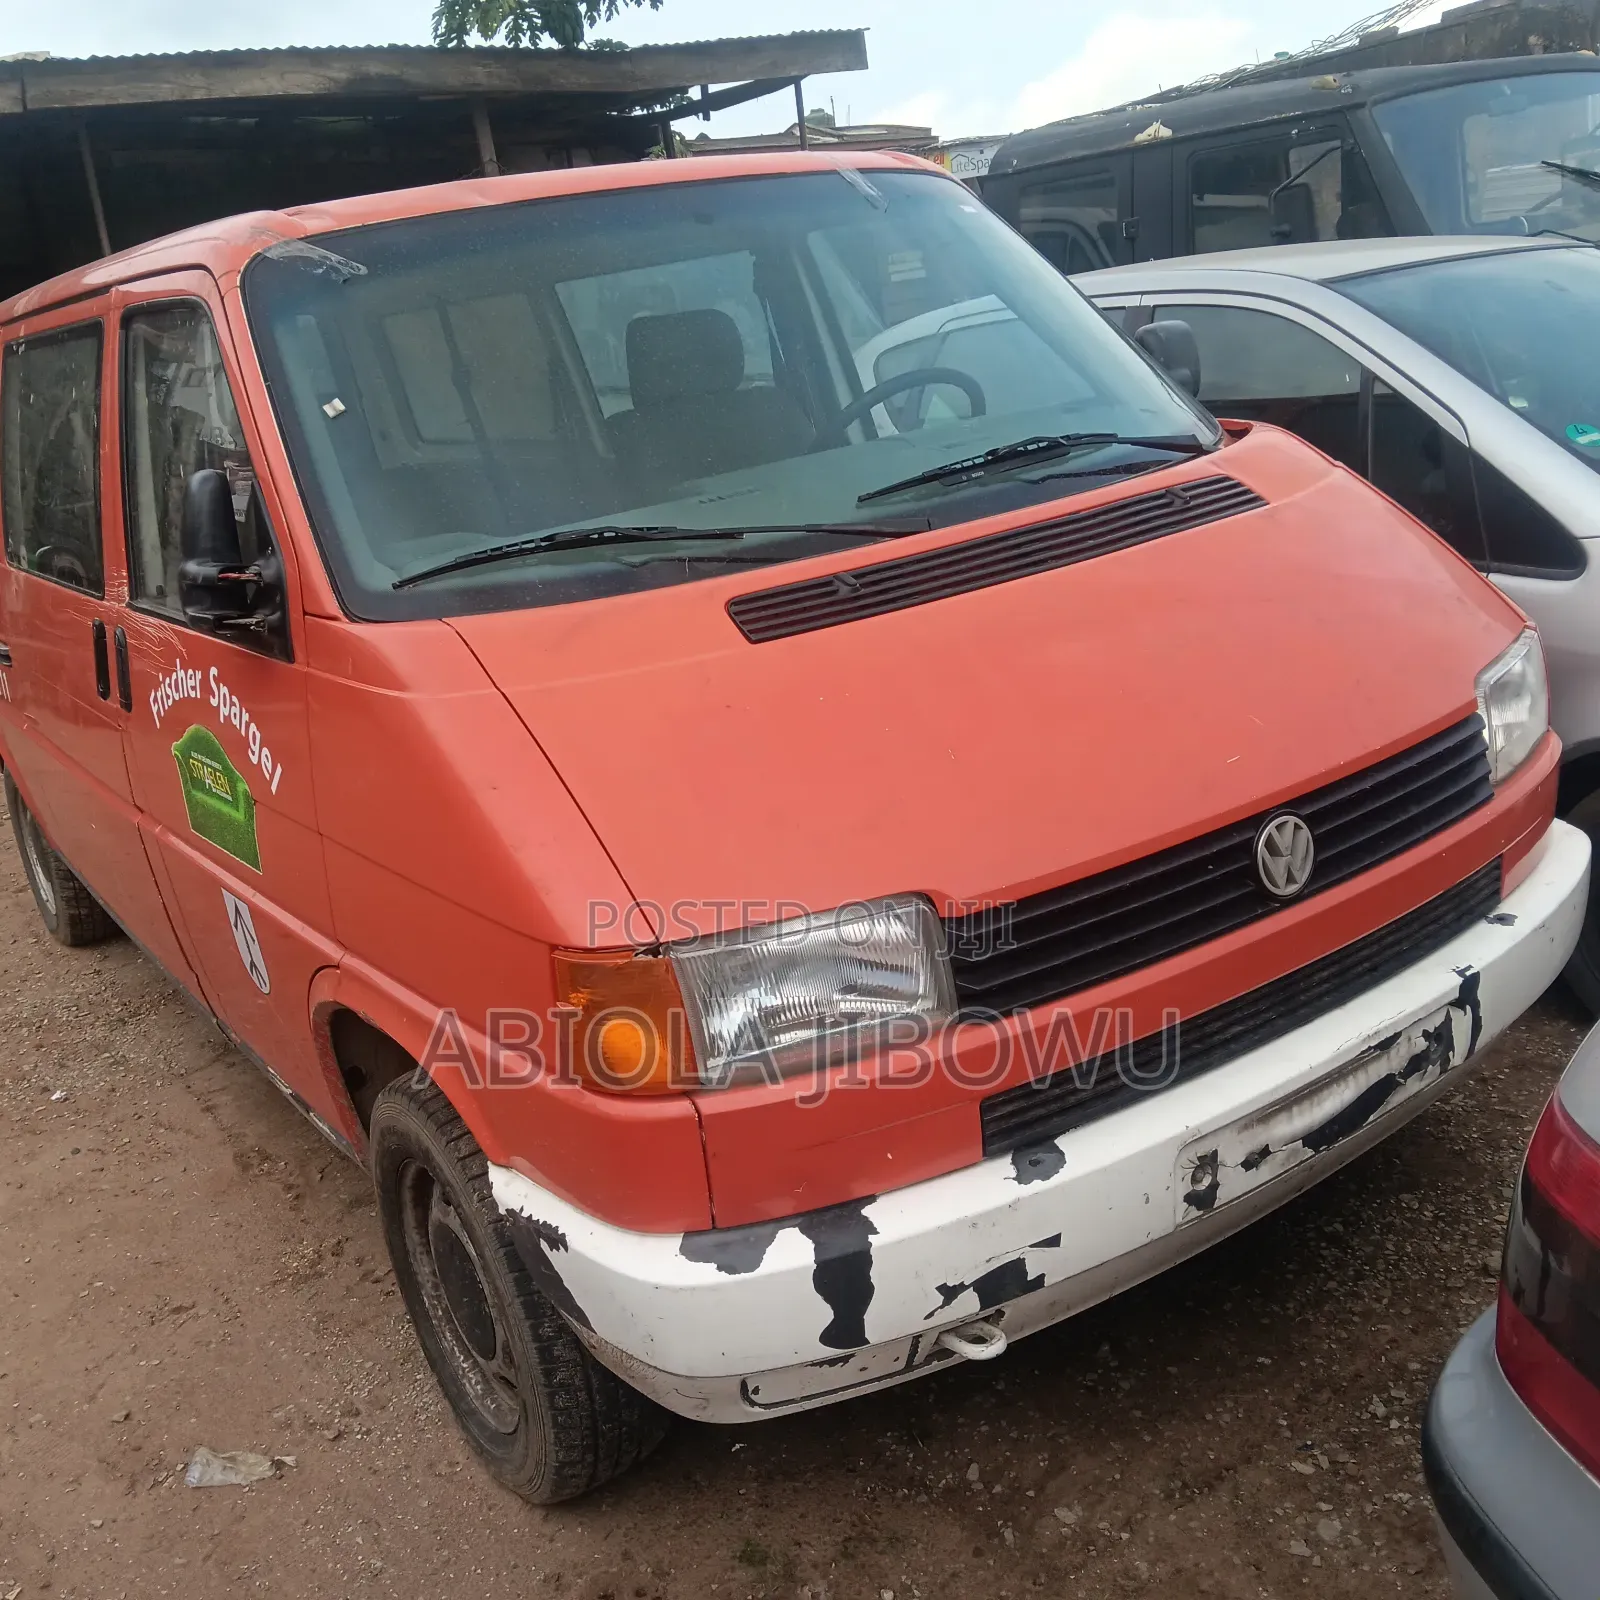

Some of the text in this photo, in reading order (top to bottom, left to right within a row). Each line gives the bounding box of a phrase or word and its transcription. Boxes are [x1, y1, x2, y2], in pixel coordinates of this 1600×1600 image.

[950, 157, 991, 174] LiteSpa
[149, 658, 283, 796] Frischer Spargel
[1257, 815, 1314, 896] VW
